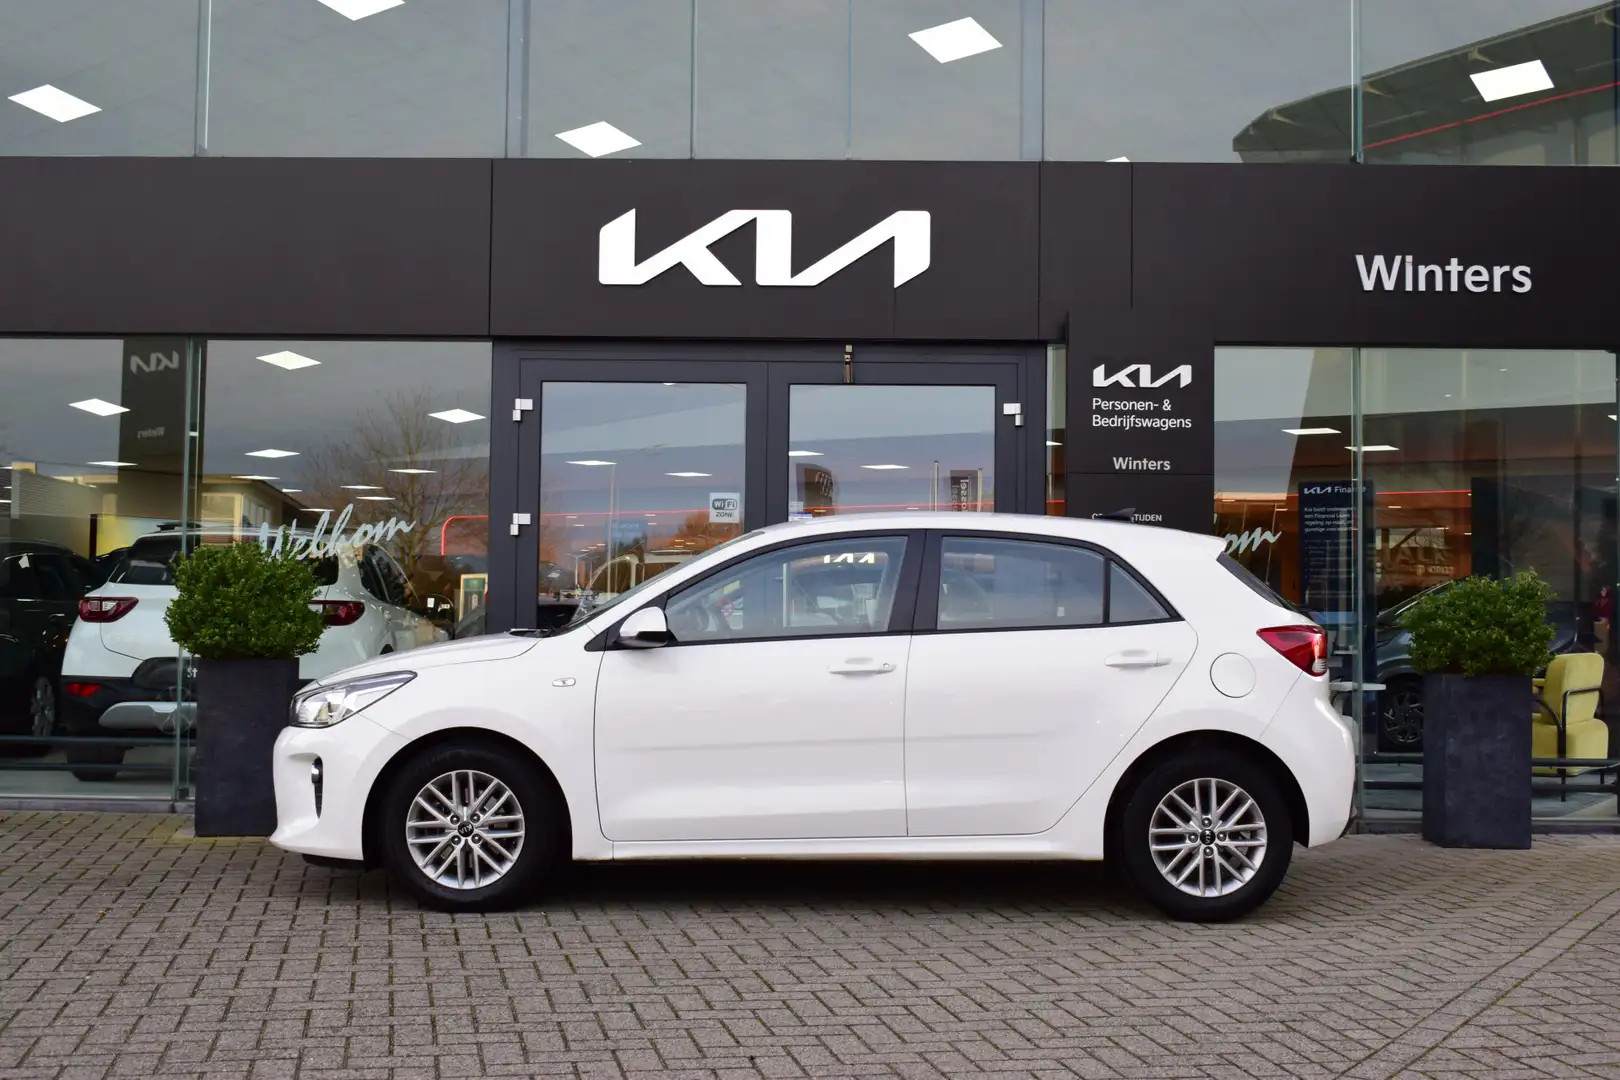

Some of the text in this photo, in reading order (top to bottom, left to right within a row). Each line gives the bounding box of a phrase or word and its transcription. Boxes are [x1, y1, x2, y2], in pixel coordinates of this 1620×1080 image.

[599, 208, 931, 288] KIA
[1355, 254, 1533, 294] Winters
[1092, 363, 1193, 389] KIA
[1092, 397, 1172, 411] Personen- &
[1092, 414, 1193, 431] Bedrijfswagens
[1113, 456, 1171, 470] Winters
[1304, 486, 1333, 495] KIA
